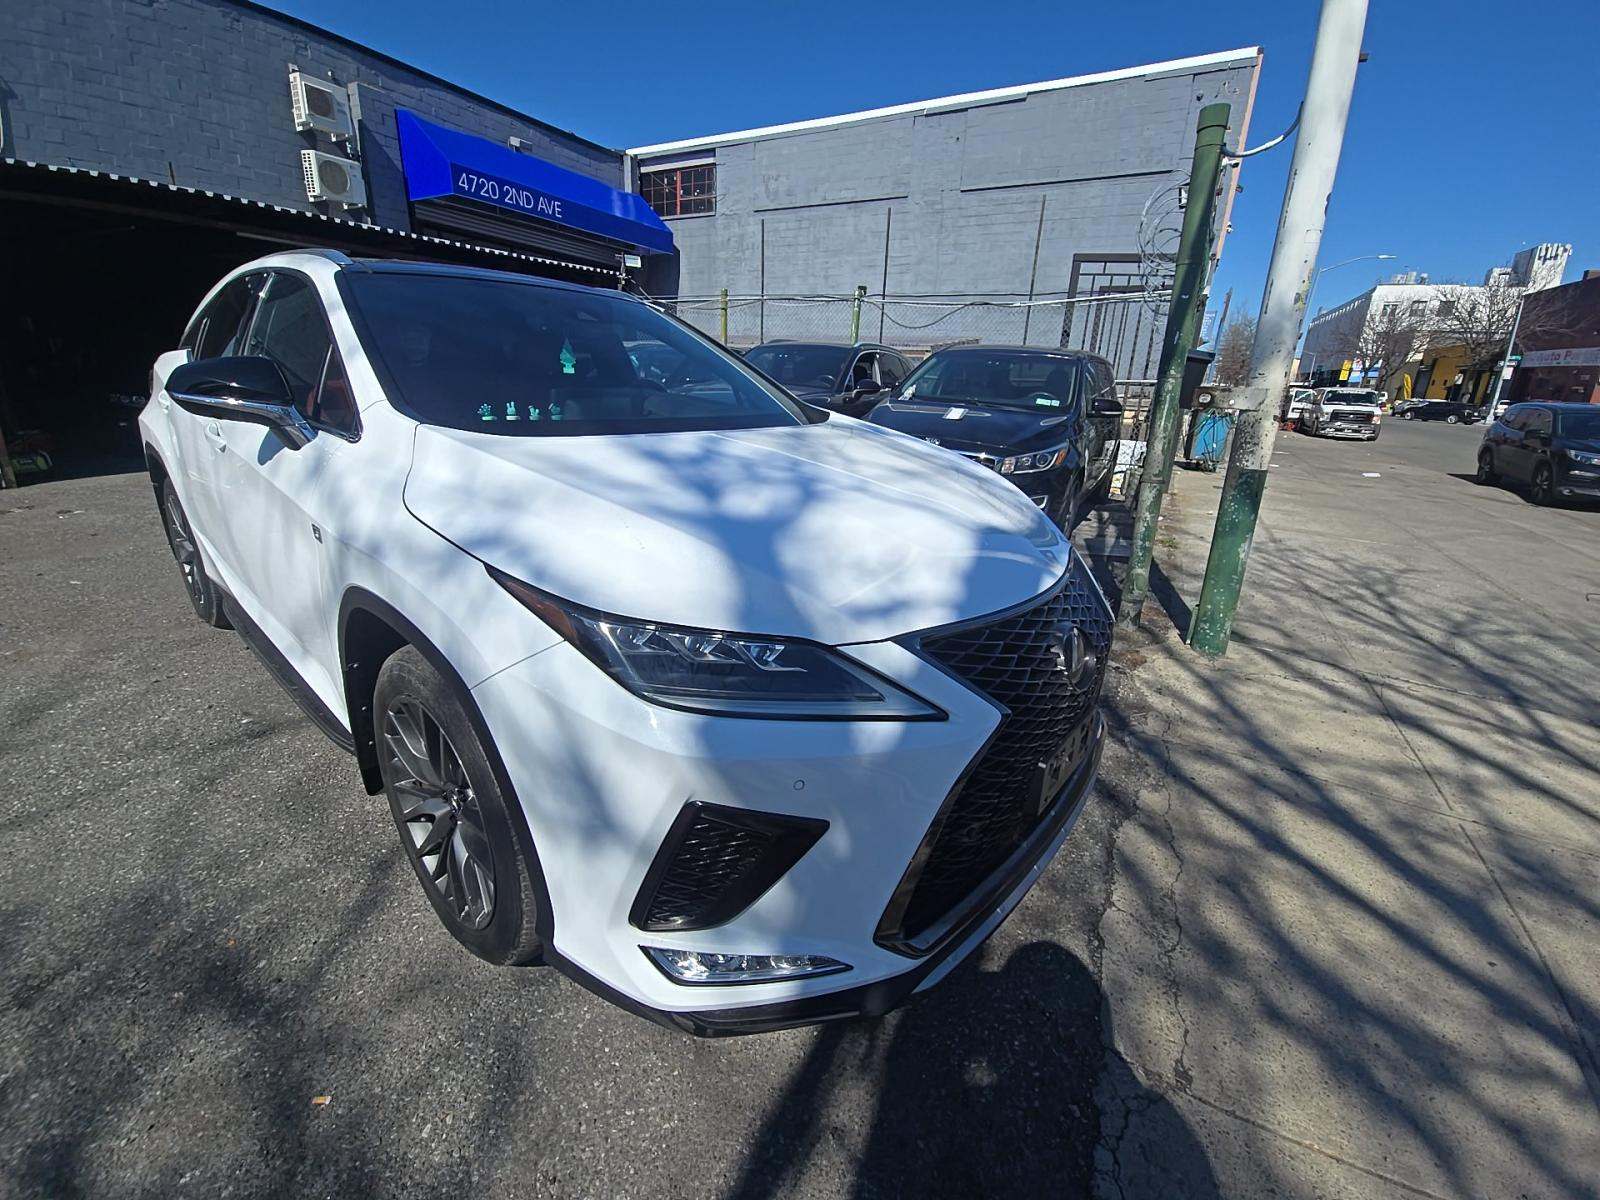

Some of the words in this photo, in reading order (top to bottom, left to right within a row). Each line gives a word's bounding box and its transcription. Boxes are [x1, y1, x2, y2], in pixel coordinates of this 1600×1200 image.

[458, 172, 499, 199] 4720
[503, 185, 534, 209] 2ND
[537, 196, 562, 218] AVE
